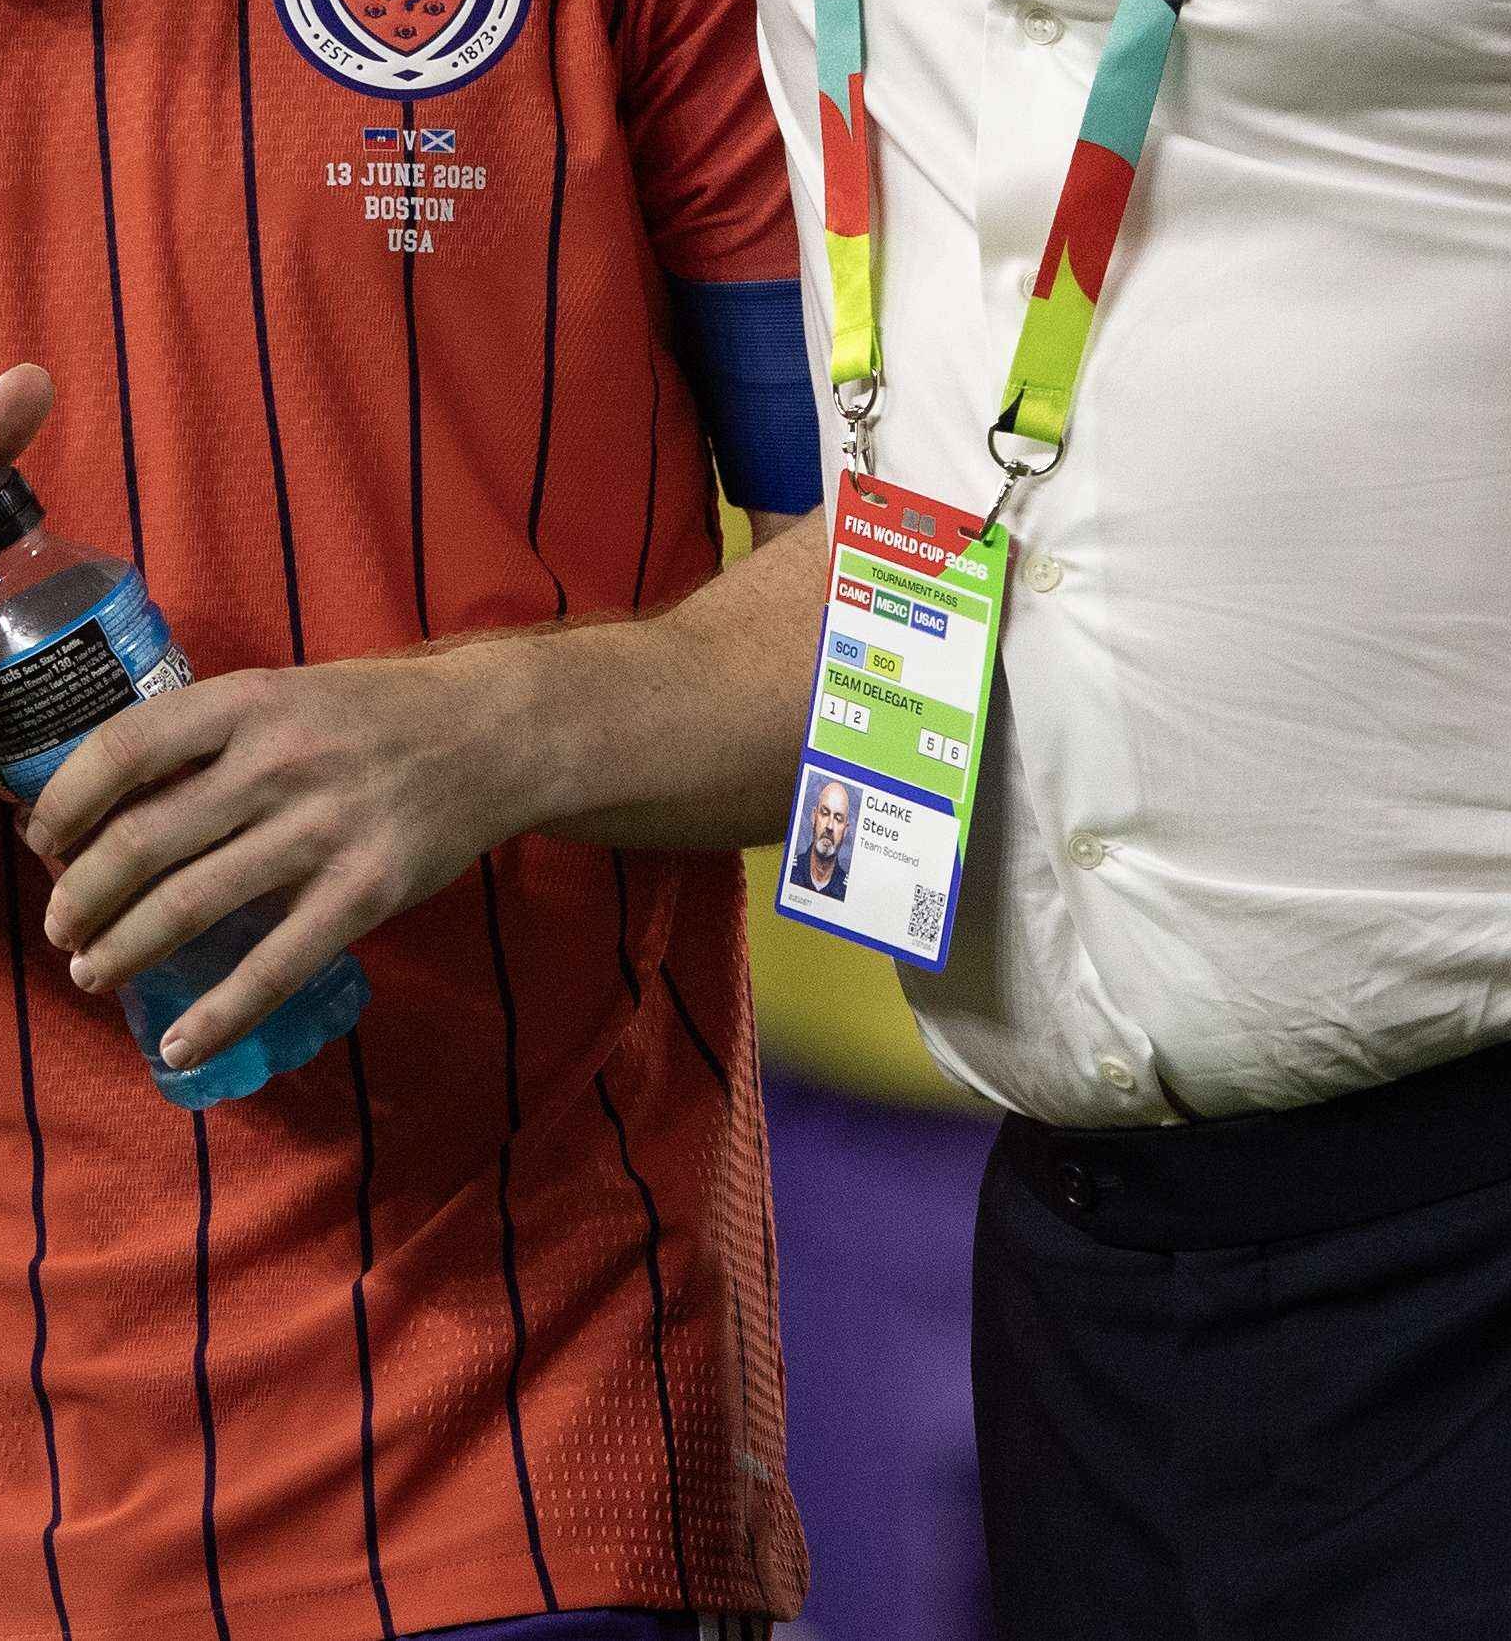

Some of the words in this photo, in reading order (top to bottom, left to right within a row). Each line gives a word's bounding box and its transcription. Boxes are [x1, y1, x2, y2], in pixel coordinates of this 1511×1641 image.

[318, 39, 353, 67] EST
[458, 31, 495, 65] 1873
[403, 130, 417, 151] V
[326, 162, 352, 186] 13
[360, 163, 426, 187] JUNE
[433, 165, 487, 190] 2026
[364, 196, 455, 222] BOSTON
[388, 229, 435, 253] USA
[845, 515, 872, 539] FIFA
[873, 524, 918, 554] WORLD
[919, 542, 944, 563] CUP
[945, 552, 988, 580] 2026
[838, 582, 870, 604] CANC
[872, 567, 932, 598] TOURNAMENT
[934, 590, 958, 608] PASS
[876, 596, 908, 618] MEXC
[914, 611, 945, 632] USAC
[835, 641, 858, 659] SCO
[873, 654, 895, 672] SCO
[828, 669, 861, 692] TEAM
[863, 681, 924, 715] DELEGATE
[830, 702, 836, 715] 1
[854, 711, 862, 724] 2
[926, 737, 935, 751] 5
[950, 746, 959, 760] 6
[866, 796, 912, 824] CLARKE
[862, 818, 899, 842] Steve
[860, 837, 883, 855] Team
[882, 845, 920, 867] Scotland
